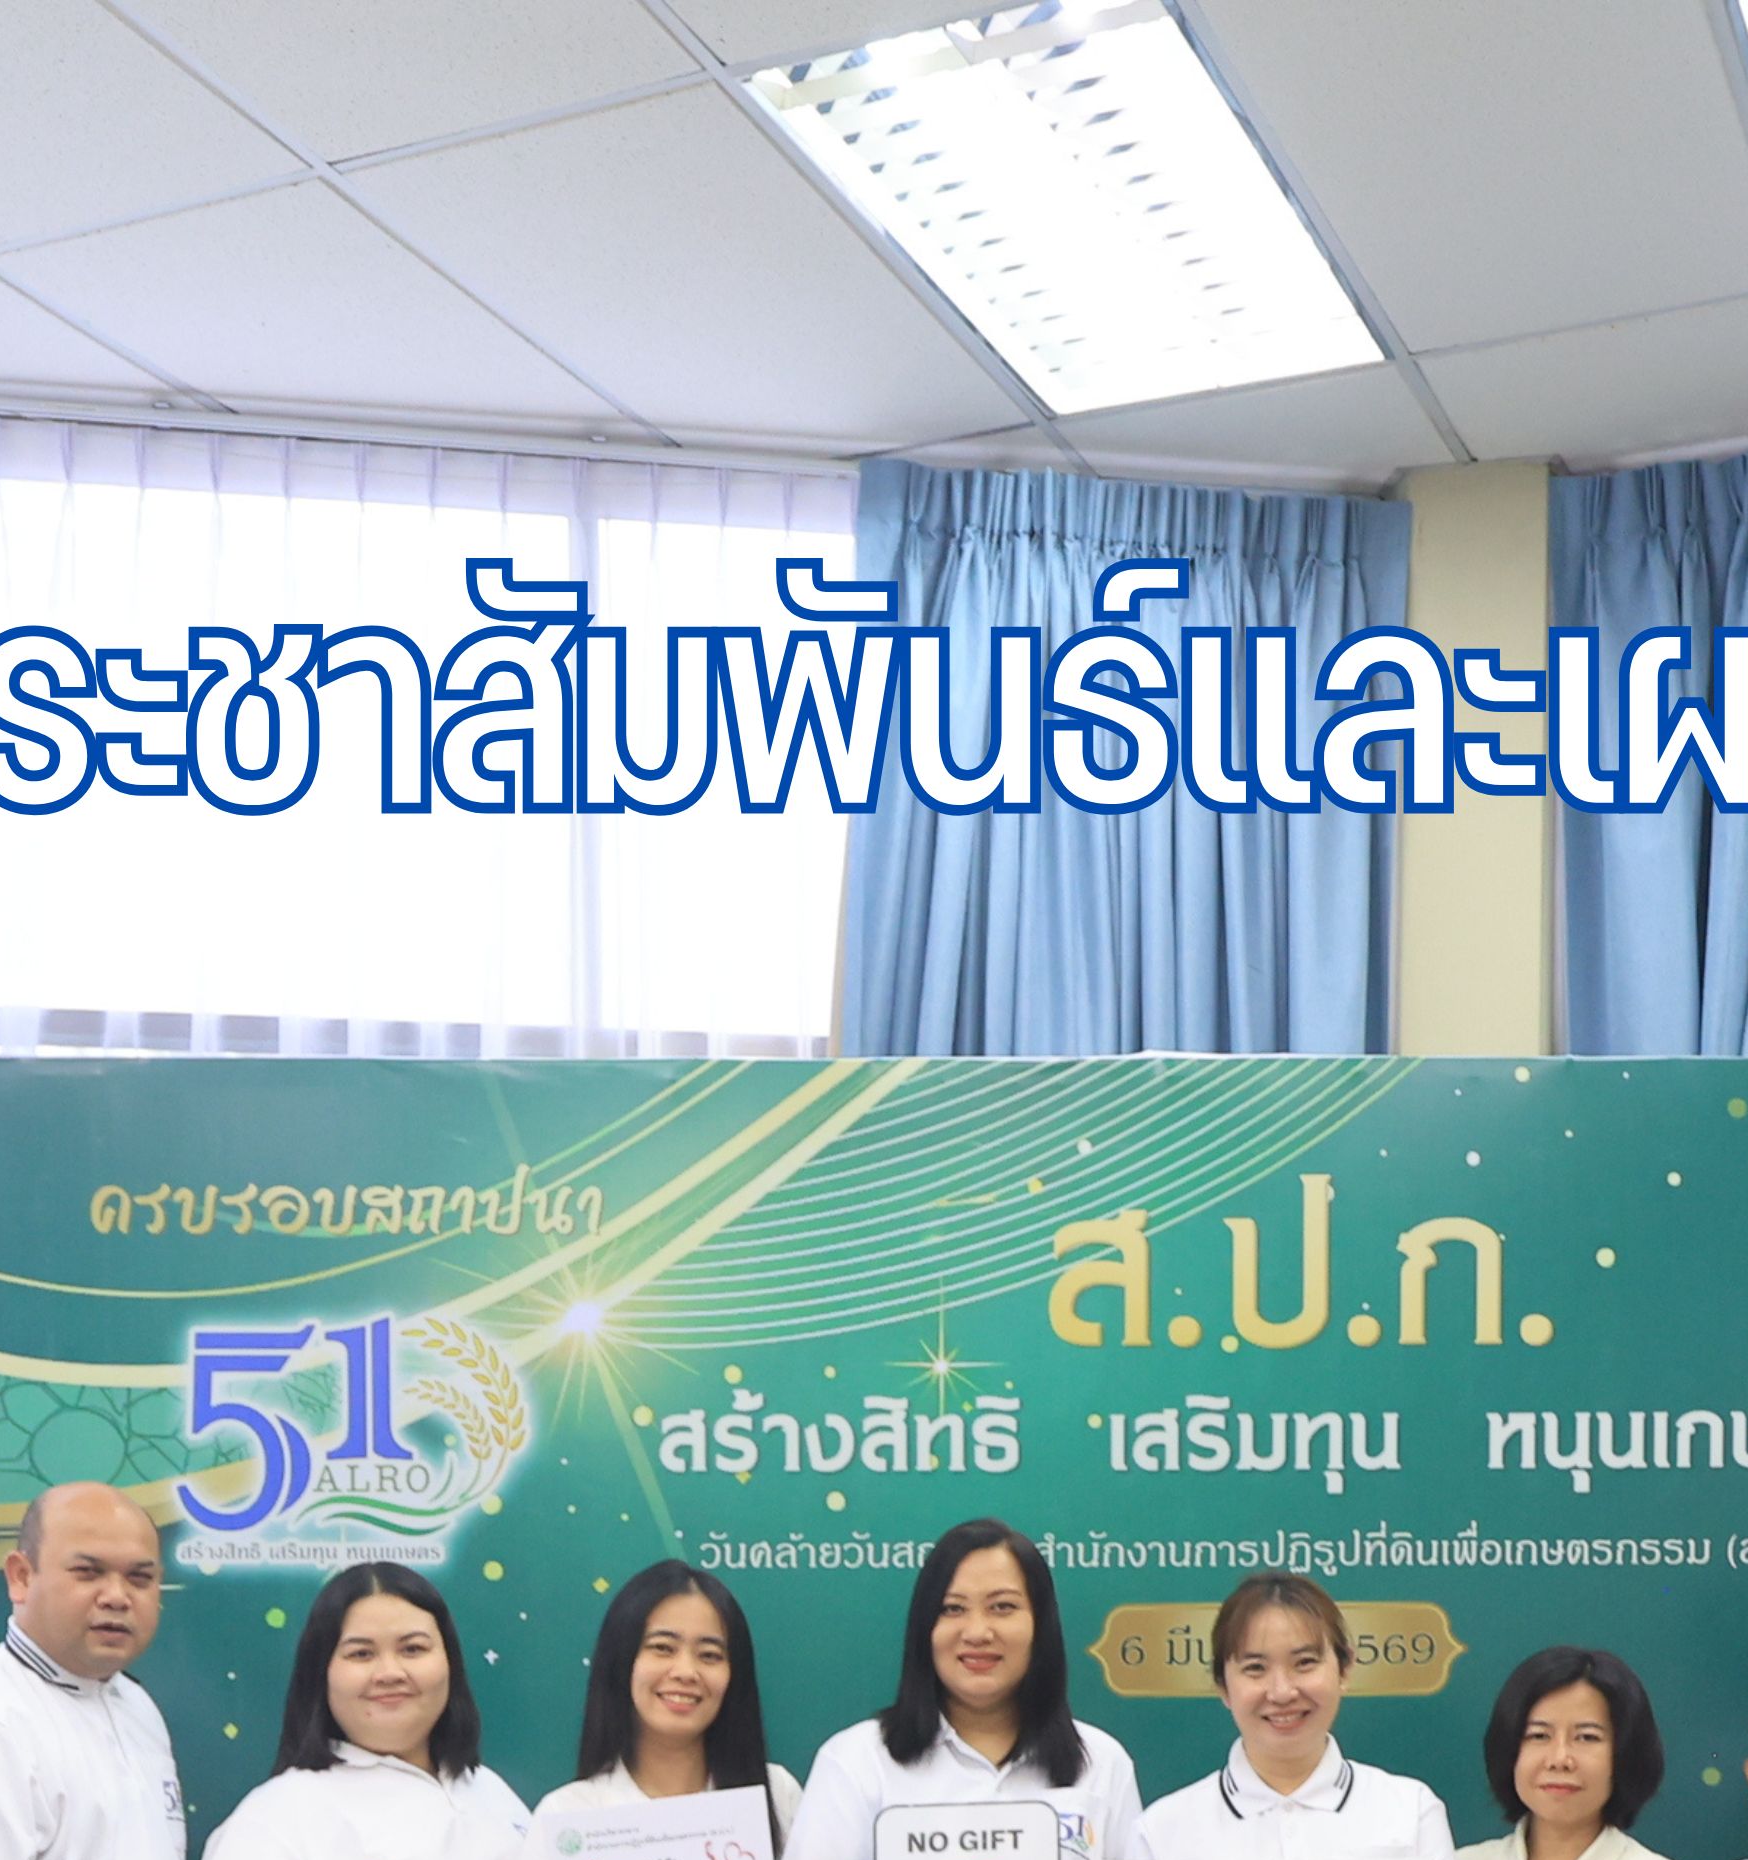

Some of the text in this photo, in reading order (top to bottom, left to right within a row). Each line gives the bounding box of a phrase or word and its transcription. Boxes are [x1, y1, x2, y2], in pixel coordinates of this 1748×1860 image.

[90, 1163, 603, 1234] ครบรอบสถาปนา
[1048, 1174, 1554, 1348] ส.ป.ก.
[177, 1317, 414, 1531] 51
[658, 1388, 1020, 1473] สร้างสิทธิ
[1109, 1395, 1402, 1496] เสริมทุน
[313, 1464, 430, 1493] ALRO
[1120, 1635, 1145, 1666] 6
[1355, 1633, 1435, 1666] 569
[907, 1829, 1024, 1854] NO GIFT
